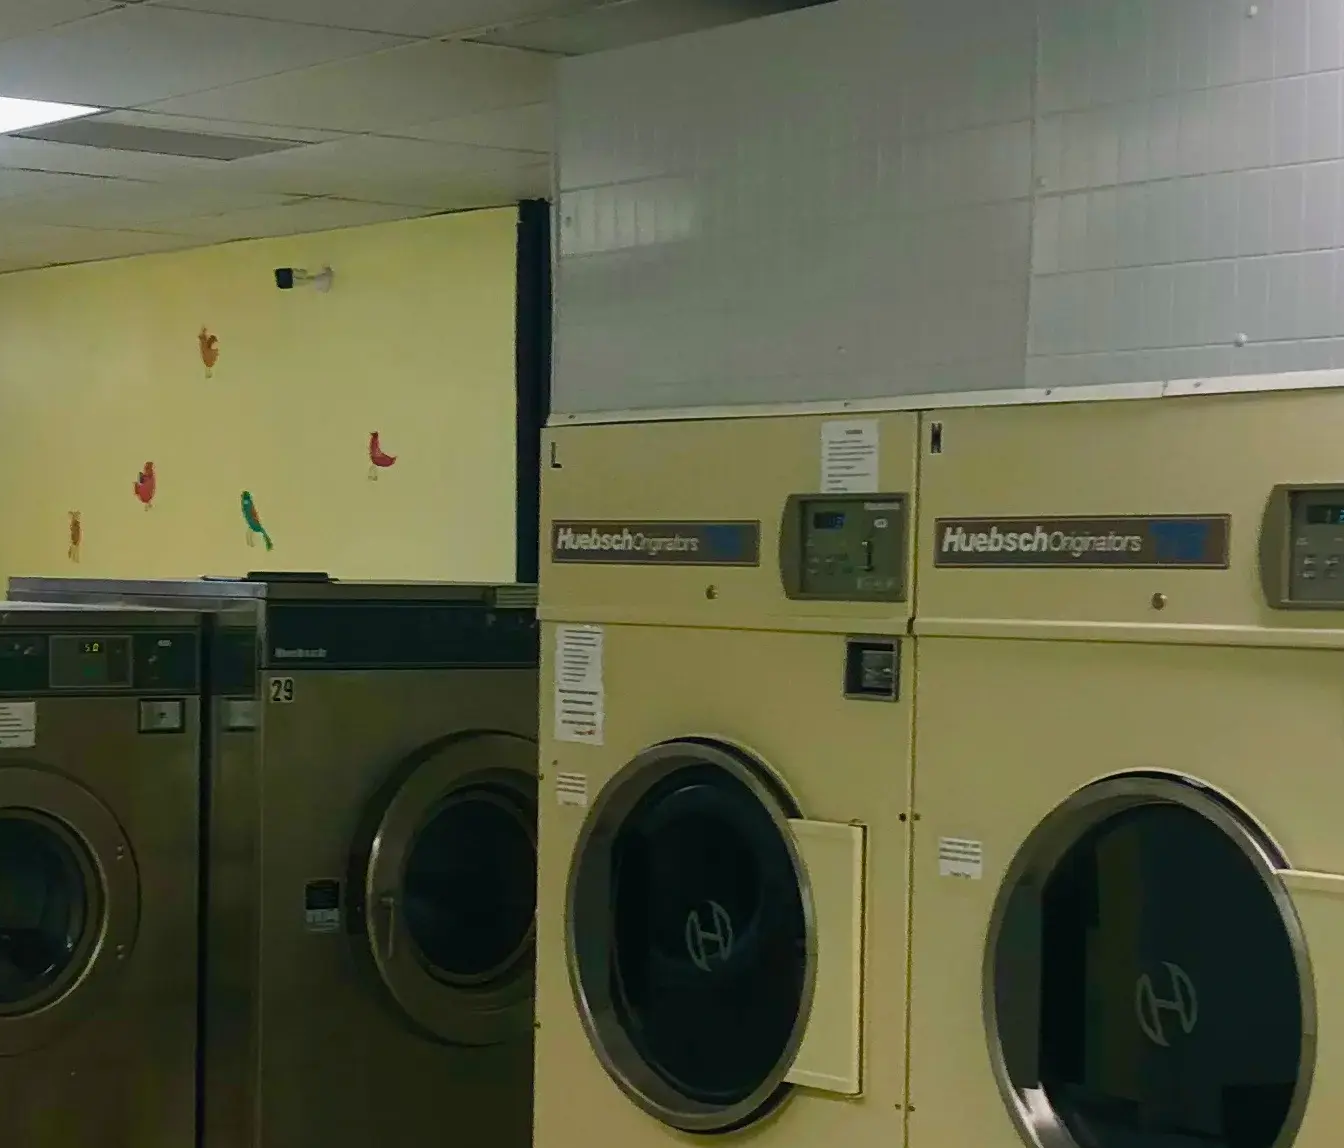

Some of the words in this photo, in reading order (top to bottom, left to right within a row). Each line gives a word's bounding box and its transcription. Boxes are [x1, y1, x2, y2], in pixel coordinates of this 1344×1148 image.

[551, 442, 562, 468] L
[557, 527, 632, 551] Huebsch
[942, 525, 1048, 553] Huebsch
[272, 679, 293, 702] 29
